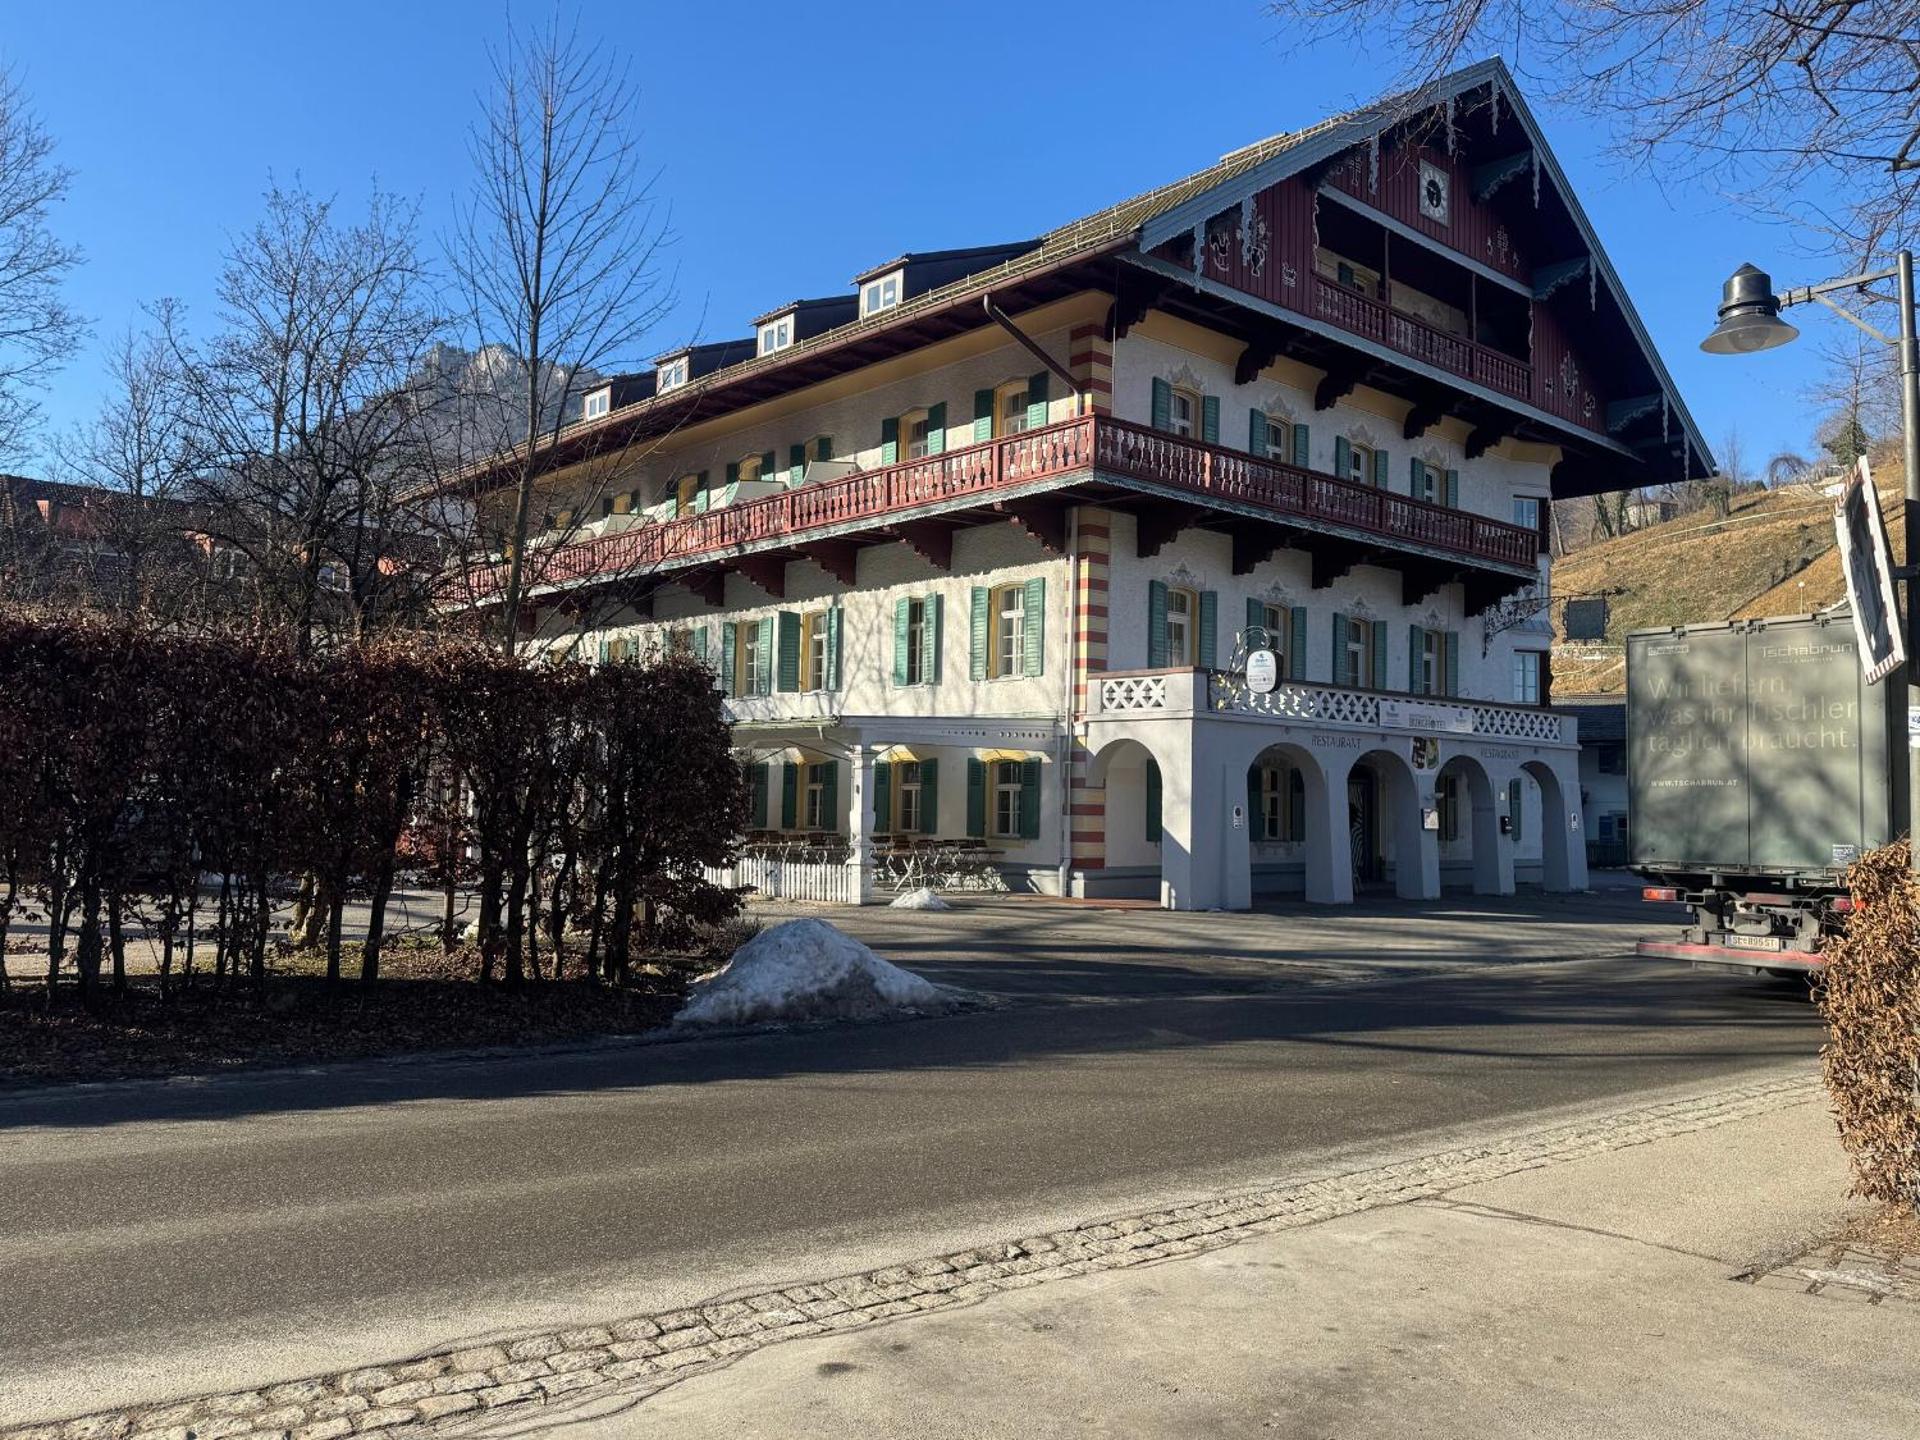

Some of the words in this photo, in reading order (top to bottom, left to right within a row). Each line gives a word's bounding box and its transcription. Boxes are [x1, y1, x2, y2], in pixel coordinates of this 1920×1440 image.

[1761, 642, 1853, 659] Tschabrun
[1648, 704, 1696, 726] was
[1750, 695, 1858, 722] Tischler
[1311, 735, 1361, 749] RESTAURANT
[1647, 728, 1733, 758] täglich
[1741, 723, 1858, 750] braucht.
